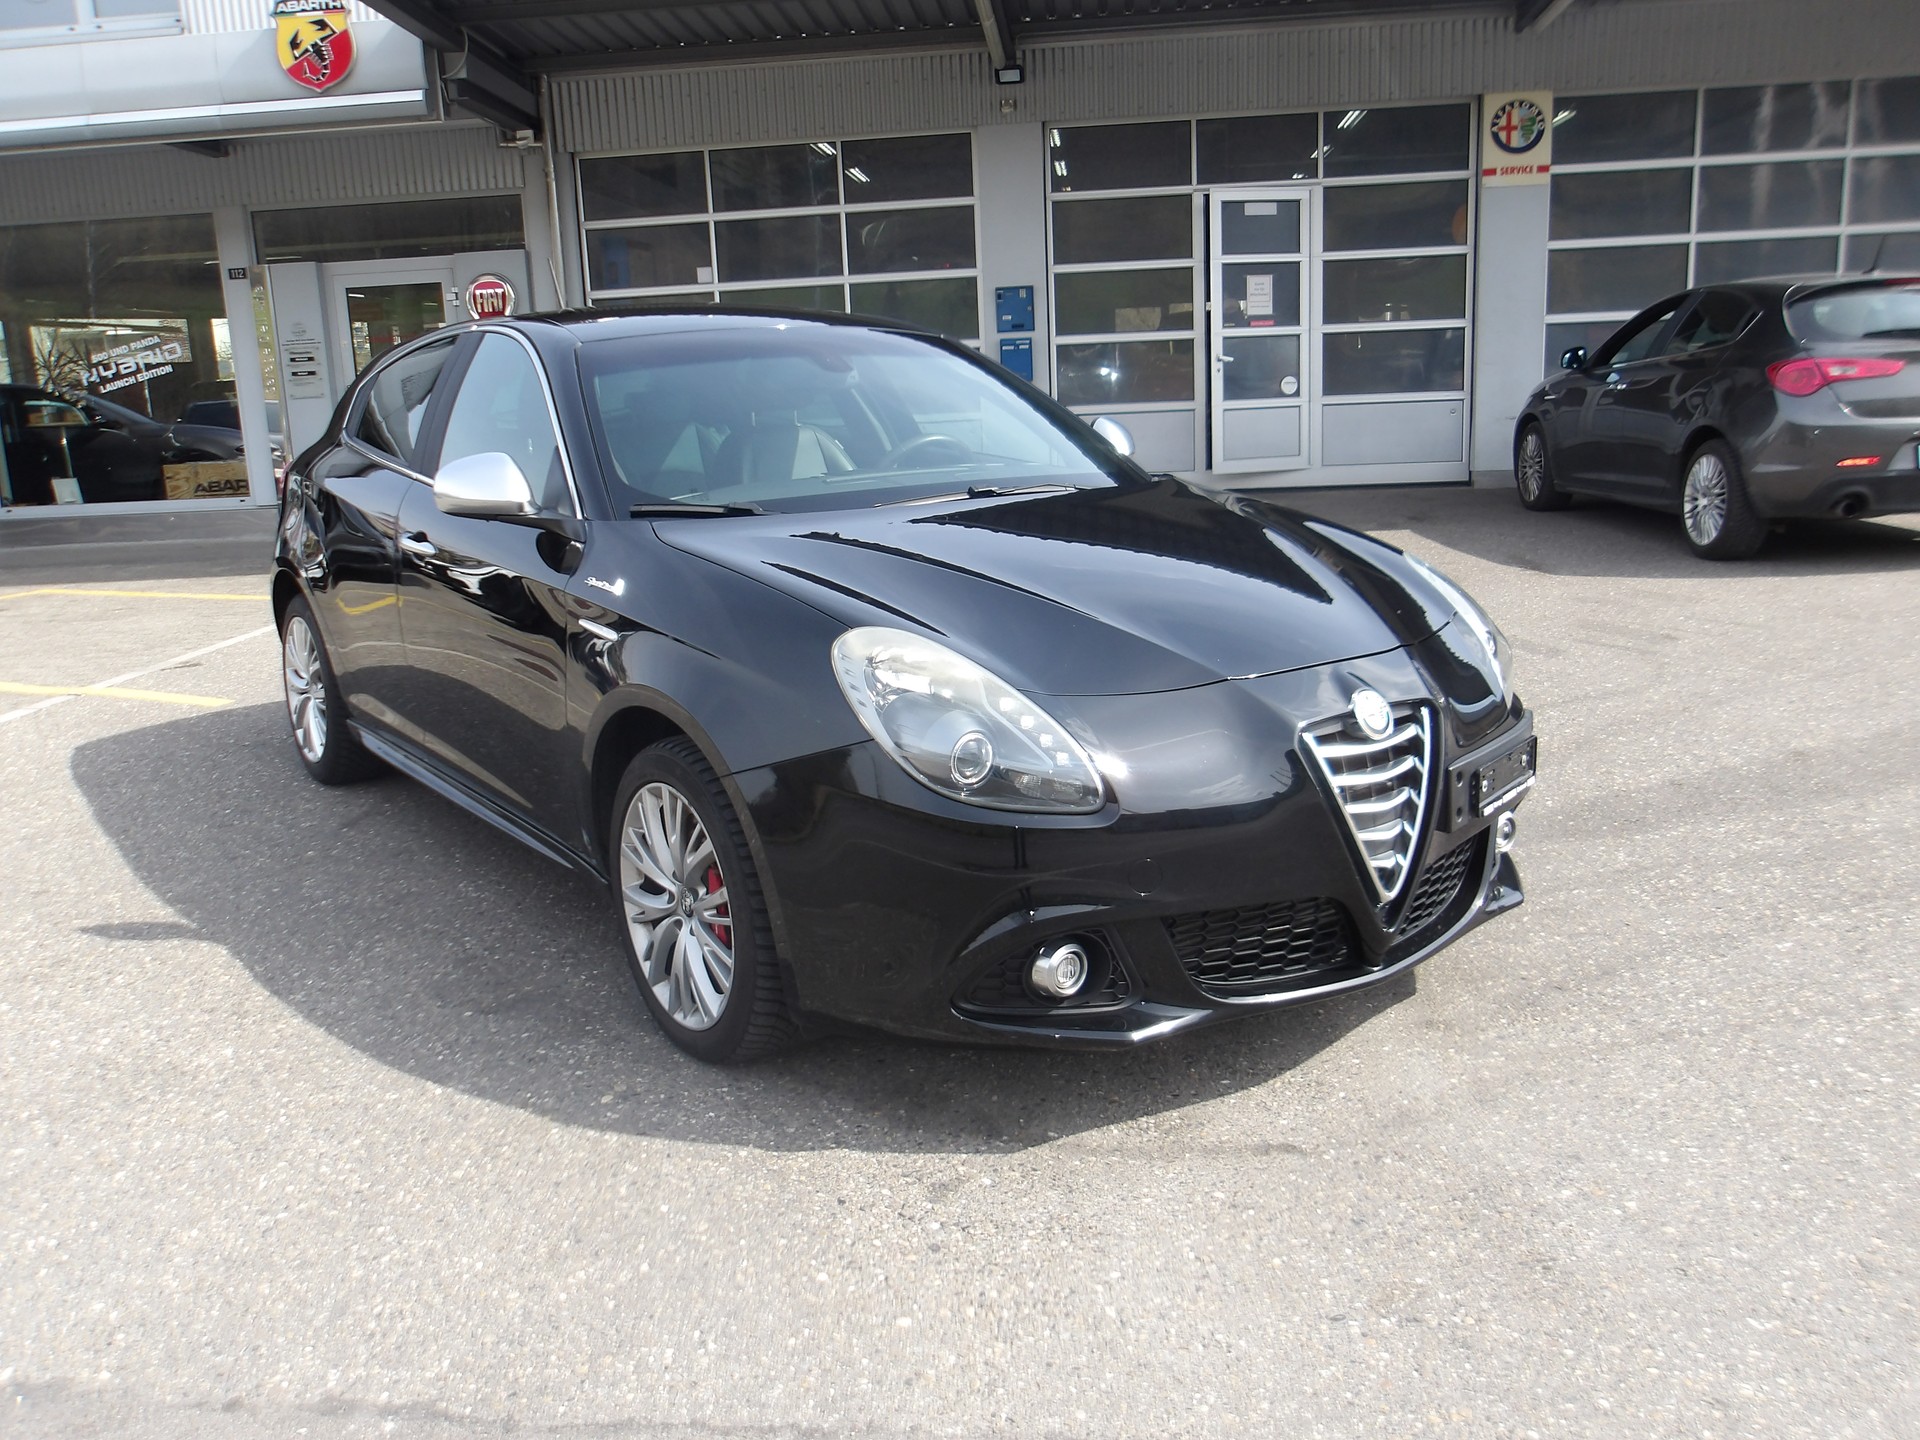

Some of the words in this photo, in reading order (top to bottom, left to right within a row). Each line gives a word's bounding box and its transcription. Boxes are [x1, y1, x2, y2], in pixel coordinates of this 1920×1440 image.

[276, 0, 342, 13] ABARTH
[1500, 164, 1535, 177] SERVICE
[230, 269, 245, 278] 112
[475, 288, 504, 313] FIAT
[91, 353, 109, 364] 500
[109, 344, 130, 358] UND
[130, 335, 162, 350] PANDA
[81, 342, 183, 387] HYBRID
[100, 375, 137, 394] LAUNCH
[136, 364, 174, 382] EDITION
